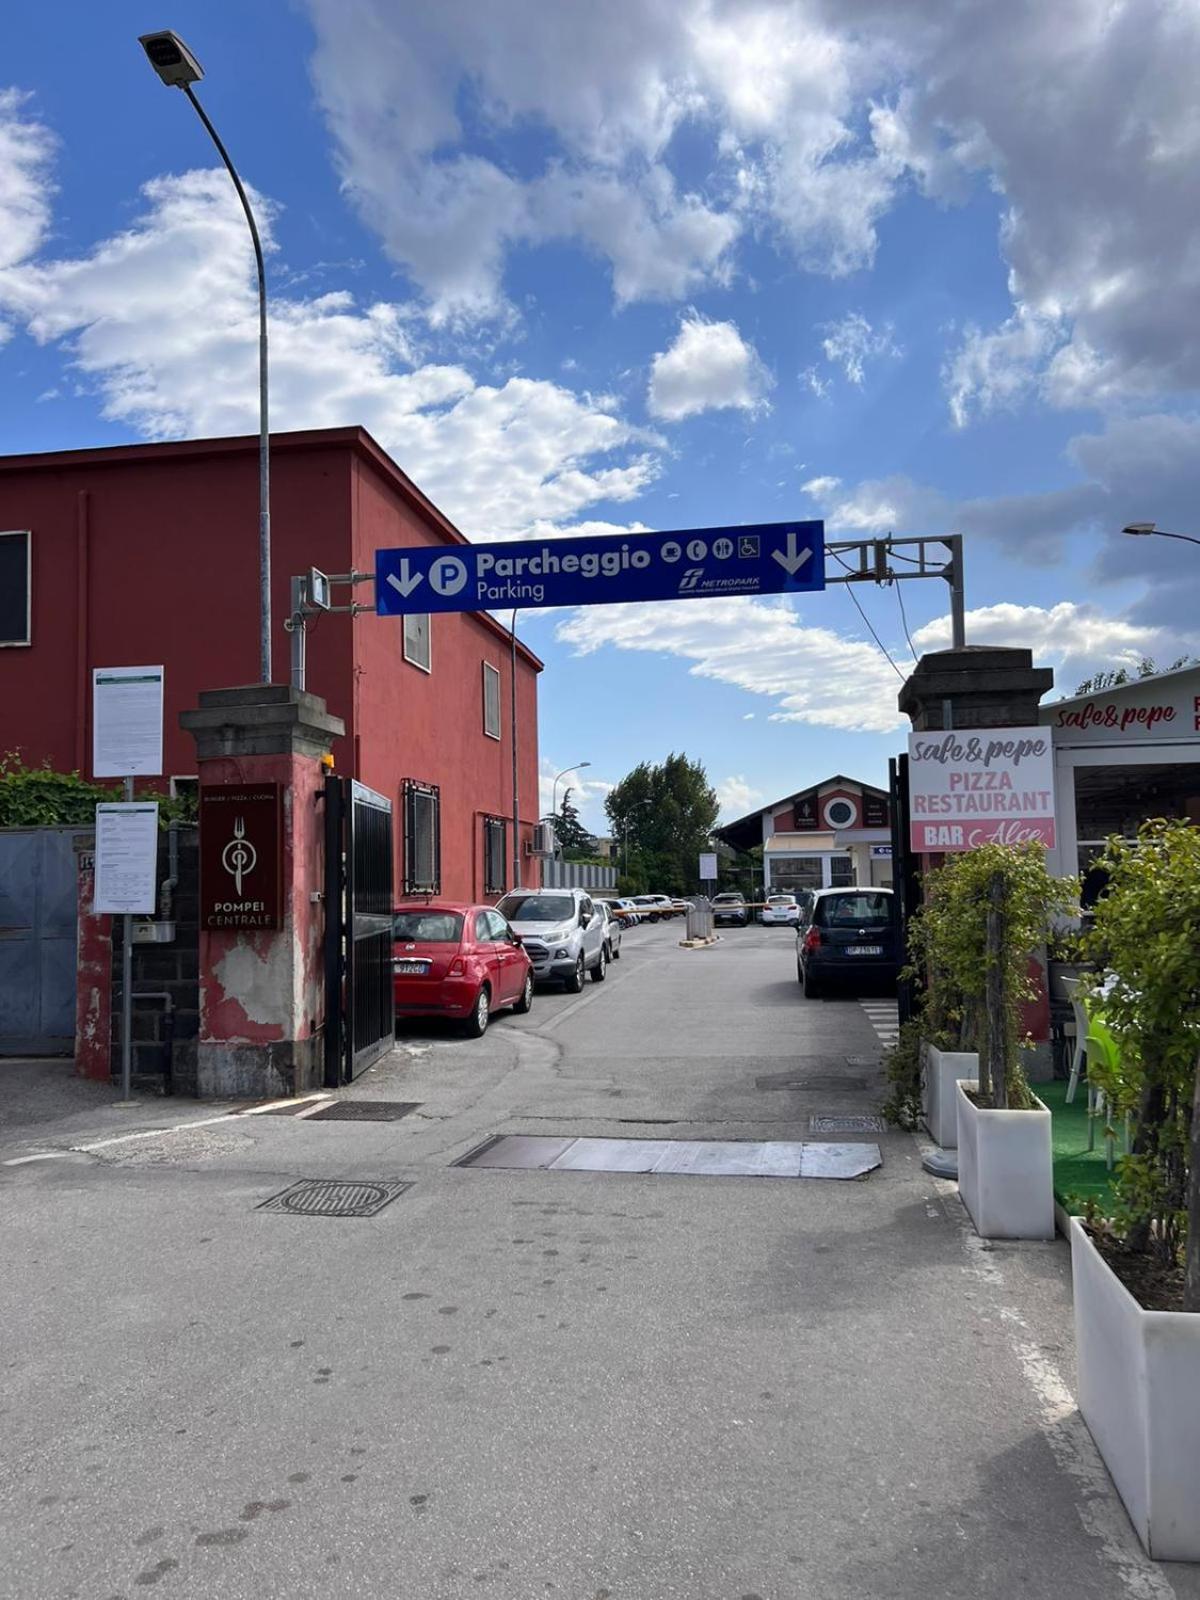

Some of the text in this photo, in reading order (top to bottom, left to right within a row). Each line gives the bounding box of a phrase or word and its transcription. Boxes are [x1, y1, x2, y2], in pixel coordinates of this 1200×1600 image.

[476, 543, 651, 579] Parcheggio
[440, 564, 460, 589] P
[477, 579, 545, 602] Parking
[949, 771, 1013, 792] PIZZA
[913, 791, 1051, 814] RESTAURANT
[924, 825, 964, 847] BAR
[214, 901, 265, 912] POMPEI
[207, 914, 272, 926] CENTRALE
